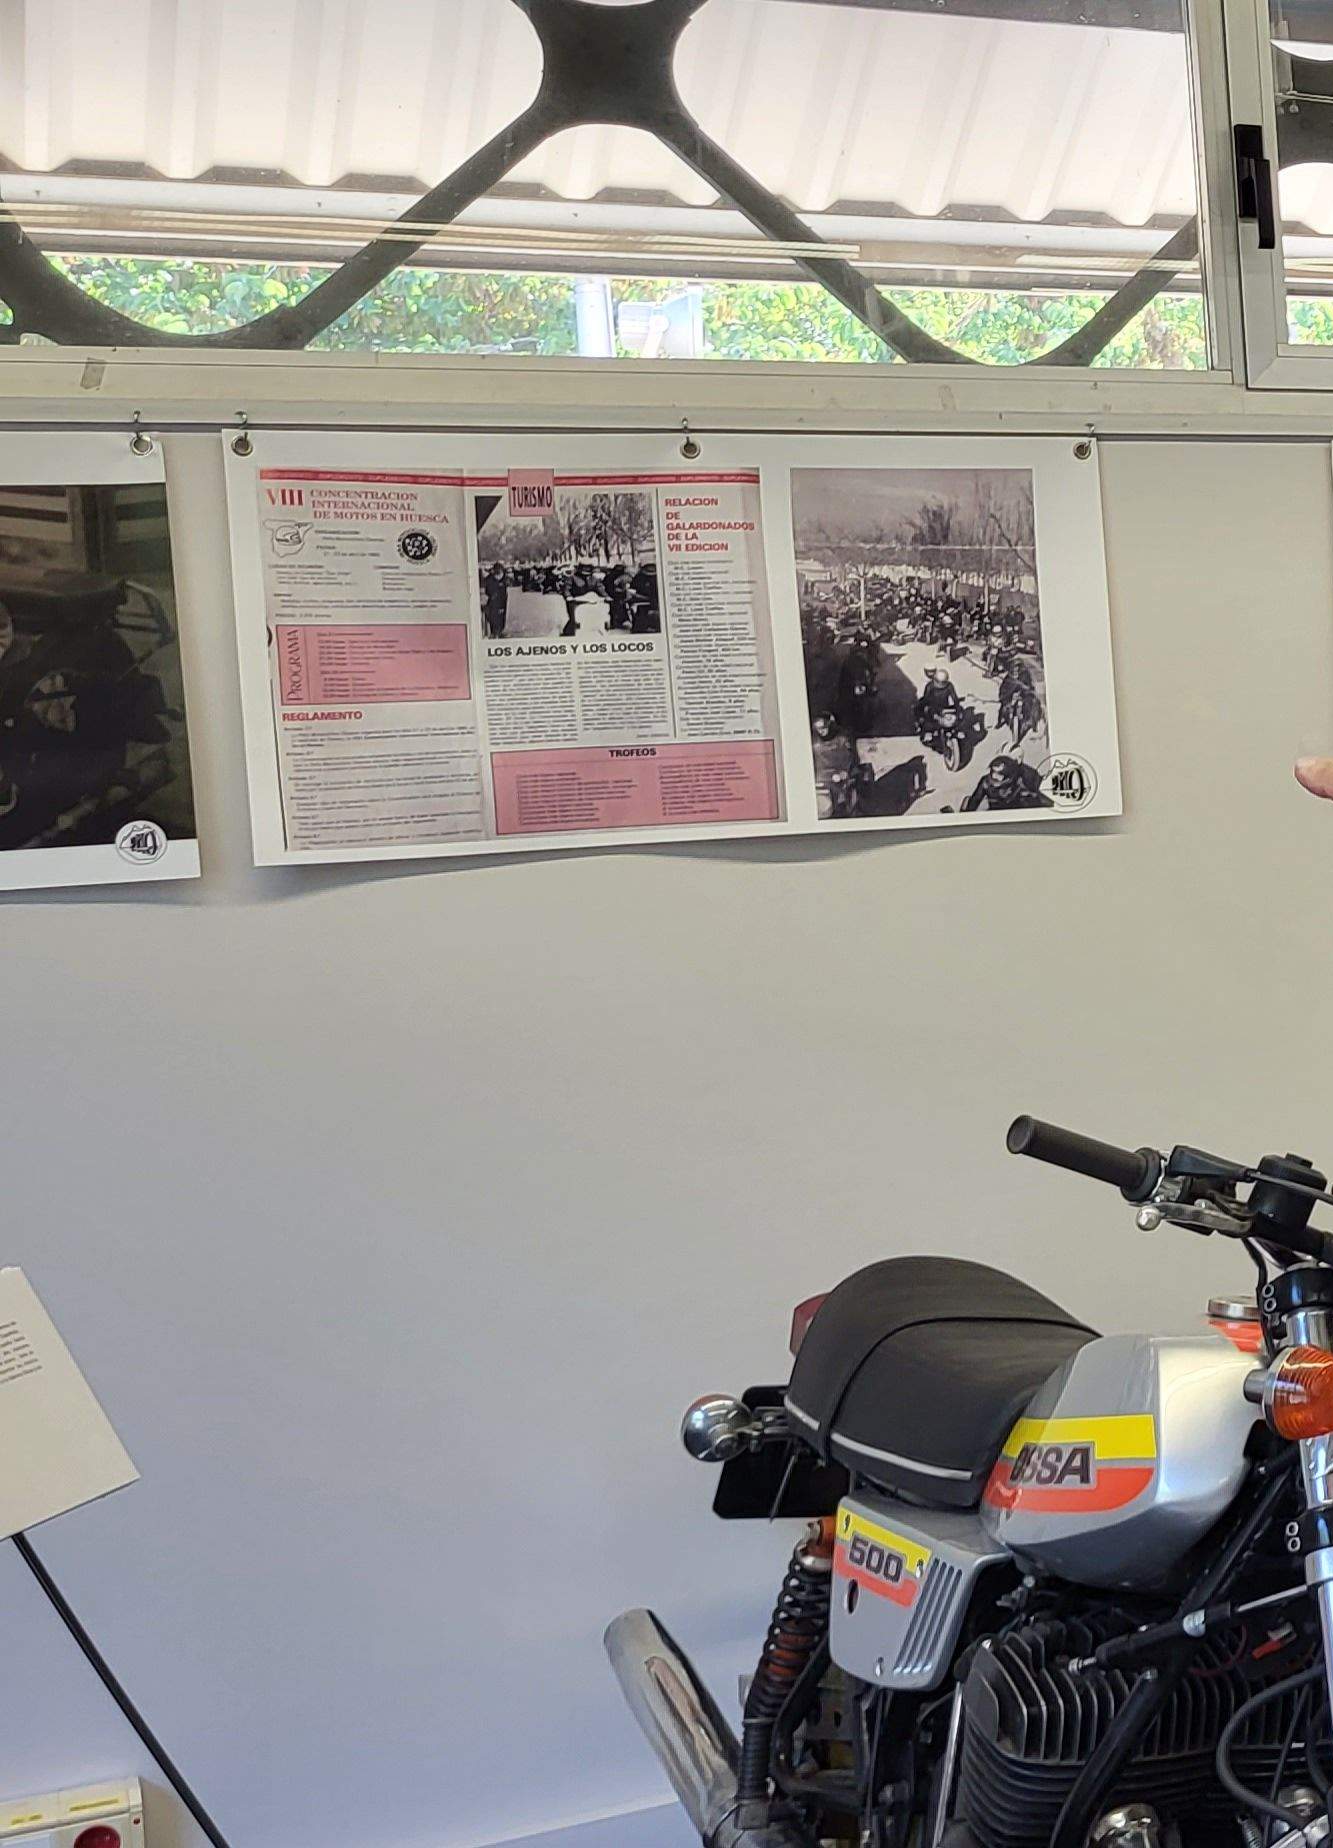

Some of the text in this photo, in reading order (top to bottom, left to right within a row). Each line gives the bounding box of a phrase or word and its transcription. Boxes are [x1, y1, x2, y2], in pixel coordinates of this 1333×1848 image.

[267, 488, 418, 506] VIII CONCENTRACION
[511, 486, 552, 508] TURISMO
[665, 498, 718, 506] RELACION
[312, 500, 414, 511] INTERNACIONAL
[314, 511, 449, 523] DE MOTOS EN HUESCA
[666, 512, 680, 520] DE
[666, 522, 755, 531] GALARDONADOS
[667, 532, 698, 541] DE LA
[668, 543, 728, 552] VII EDICION
[488, 642, 654, 657] LOS AJENOS Y LOS LOCOS
[287, 629, 303, 701] PROGRAMA
[282, 711, 363, 722] REGLAMENTO
[609, 748, 657, 758] TROFEOS
